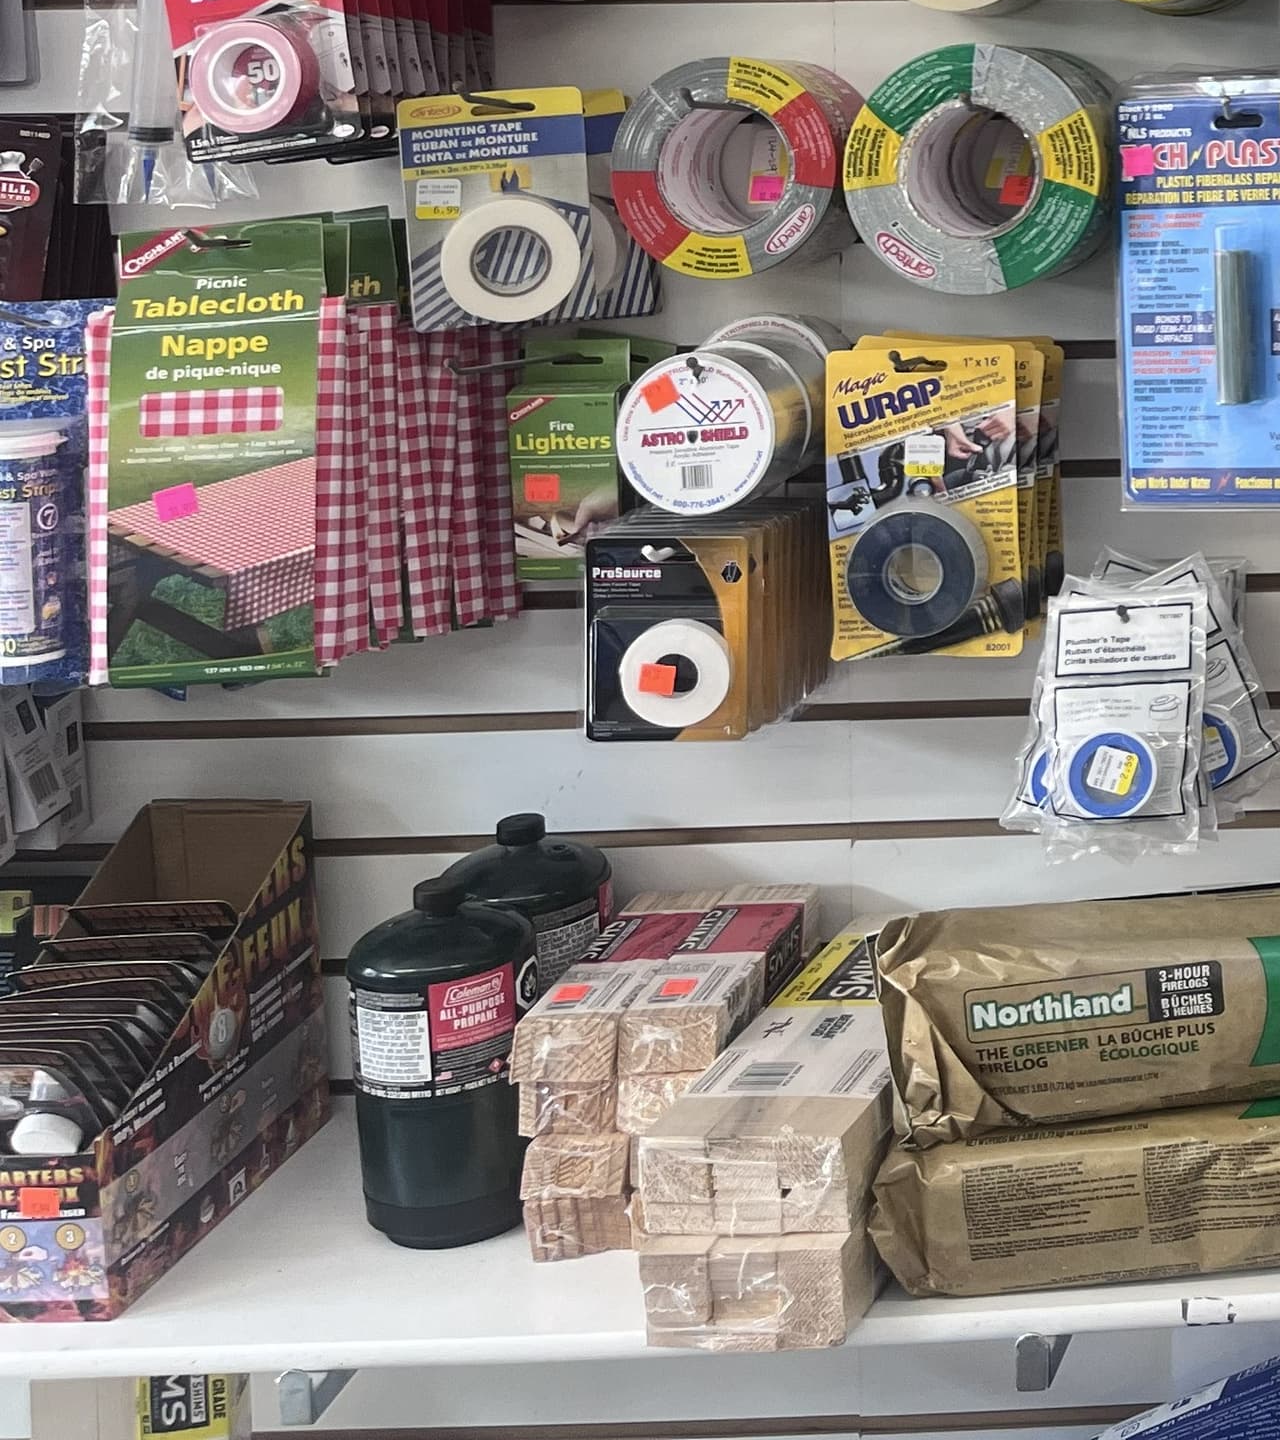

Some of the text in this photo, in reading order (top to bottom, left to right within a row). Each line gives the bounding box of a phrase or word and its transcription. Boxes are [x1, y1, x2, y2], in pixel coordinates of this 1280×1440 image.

[411, 122, 522, 140] MOUNTING TAPE
[433, 205, 460, 217] 6.99
[196, 276, 248, 289] Picnic
[132, 290, 304, 319] Tablecloth
[161, 334, 268, 359] Nappe
[173, 361, 282, 381] pique-nique
[831, 373, 888, 398] Magic
[840, 378, 940, 428] WRAP
[550, 421, 574, 432] Fire
[640, 426, 748, 447] ASTRO SHIELD
[516, 431, 611, 451] Lighters
[592, 566, 661, 579] ProSource
[1159, 965, 1210, 982] 3-HOUR
[1161, 979, 1209, 992] FIRELOGS
[440, 993, 505, 1020] ALL-PURPOSE
[971, 983, 1133, 1031] Northland
[454, 1008, 498, 1030] PROPANE
[1098, 1022, 1215, 1046] LA BÛCHE PLUS
[976, 1038, 1089, 1062] THE GREENER
[1100, 1040, 1199, 1061] ÉCOLOGIQUE
[979, 1057, 1048, 1073] FIRELOG
